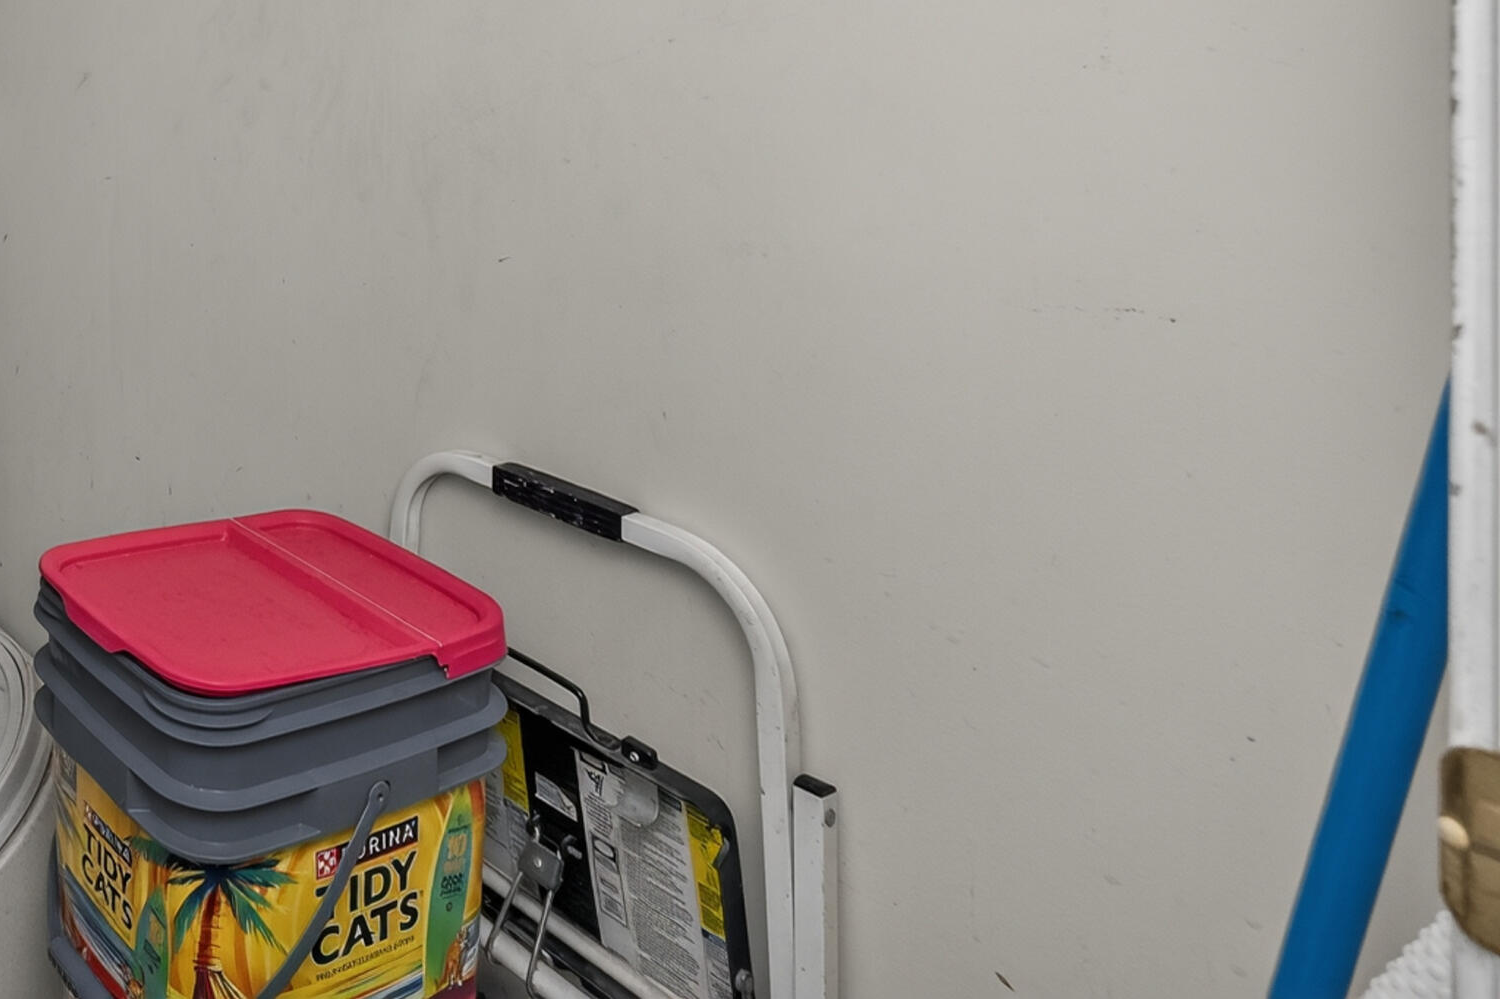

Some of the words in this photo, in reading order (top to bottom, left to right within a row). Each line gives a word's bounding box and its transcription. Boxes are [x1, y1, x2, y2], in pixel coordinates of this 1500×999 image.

[82, 854, 133, 930] CATS
[83, 823, 132, 894] TIDY
[311, 892, 418, 965] CATS
